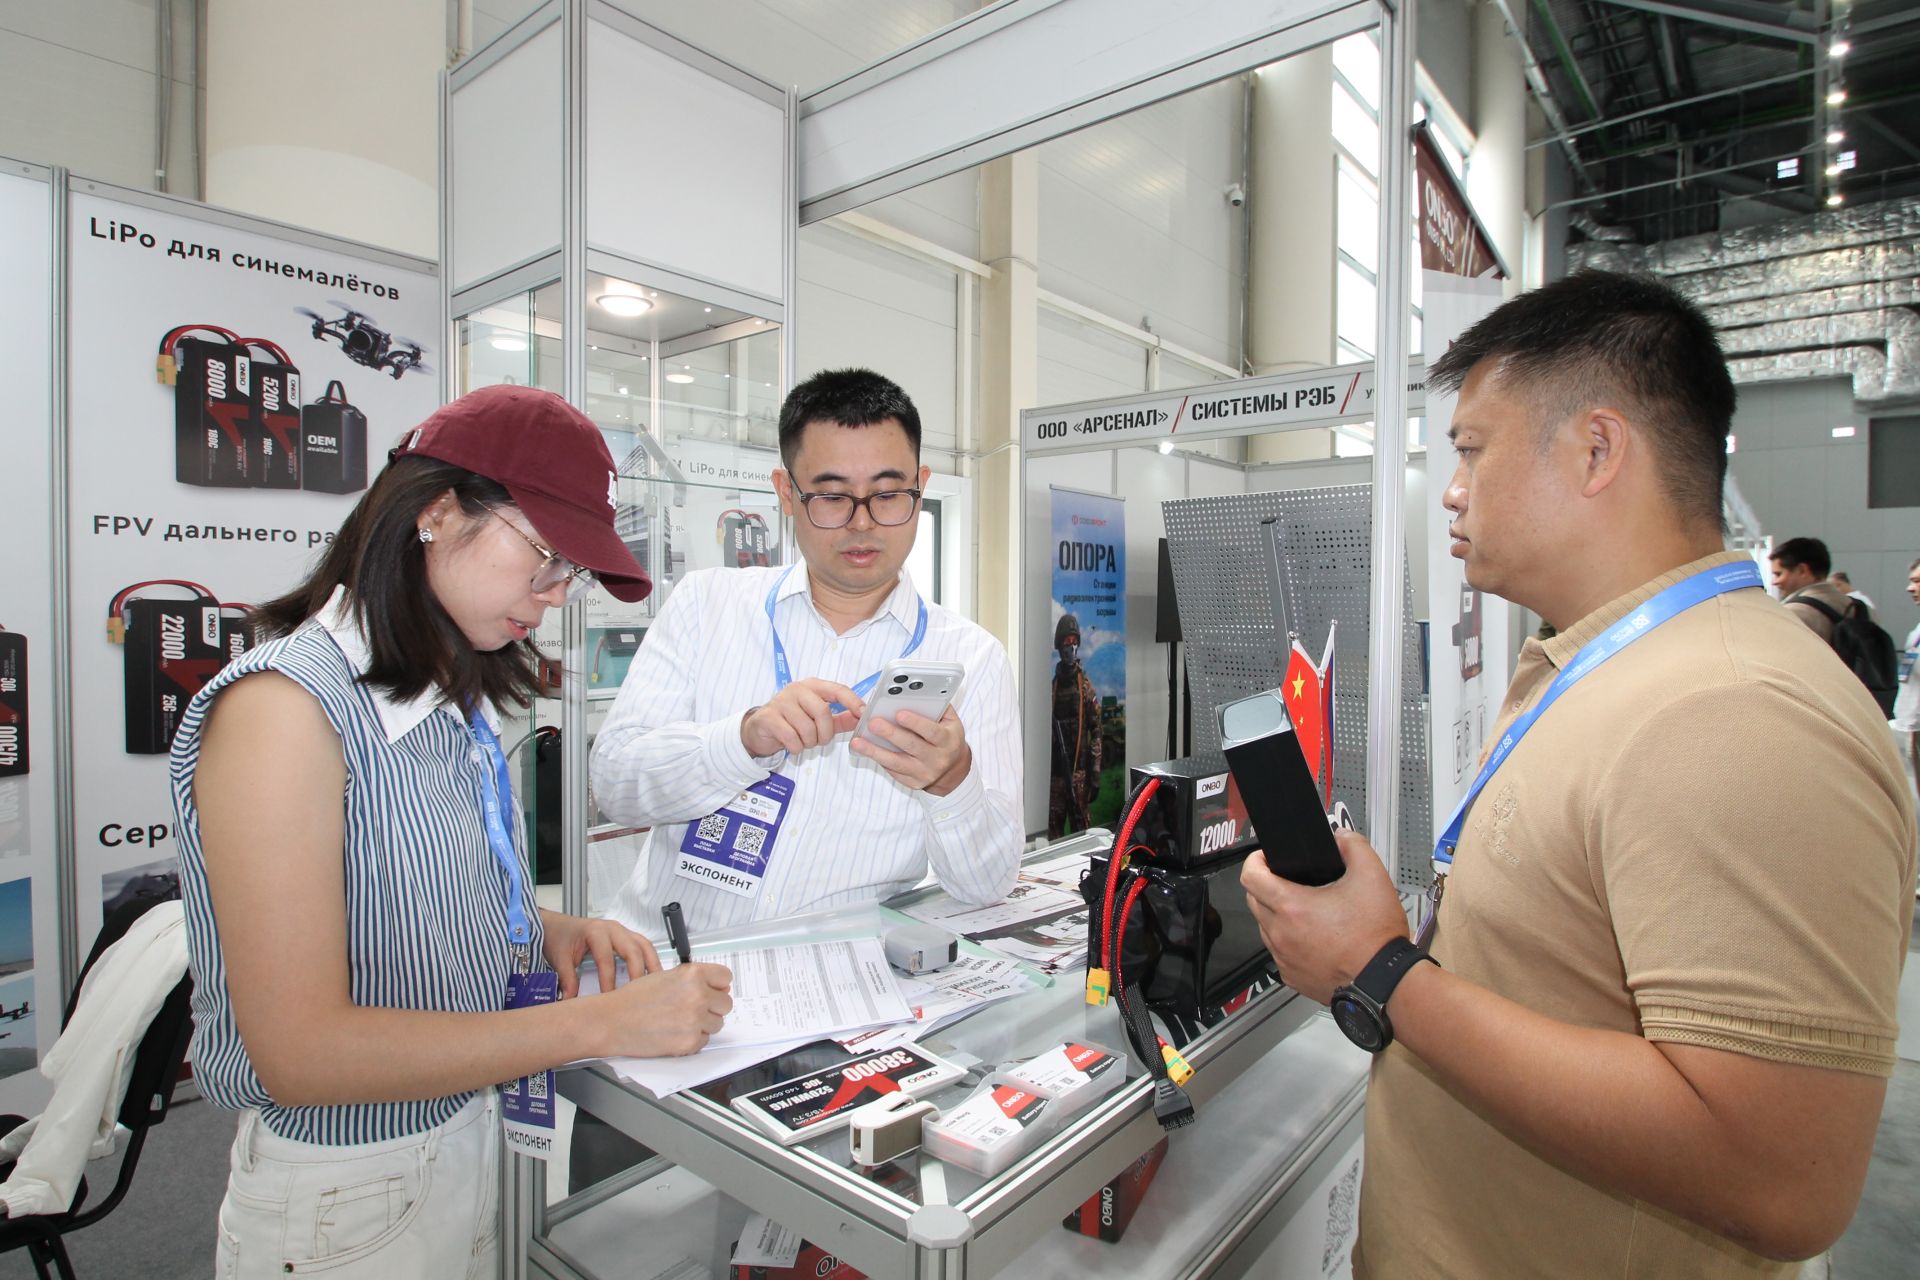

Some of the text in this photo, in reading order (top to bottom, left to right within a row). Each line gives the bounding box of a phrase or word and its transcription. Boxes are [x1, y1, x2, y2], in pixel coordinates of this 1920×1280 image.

[90, 217, 400, 301] LiPo для синемалётов
[207, 358, 226, 399] 8000
[262, 376, 280, 411] 5200
[1191, 385, 1336, 421] СИСТЕМЫ РЭБ
[1037, 409, 1169, 440] ООО «АРСЕНАЛ»
[307, 435, 337, 448] OEM
[689, 462, 715, 475] LiPo
[718, 468, 739, 478] для
[93, 515, 154, 537] FPV
[164, 523, 297, 544] дальнего
[1059, 540, 1117, 573] ОПОРА
[160, 613, 185, 661] 22000
[208, 613, 217, 638] ONBO
[229, 632, 244, 660] 1600
[0, 677, 17, 692] 10C
[162, 694, 177, 712] 25C
[1201, 780, 1221, 793] ONBO
[1199, 818, 1236, 855] 12000
[680, 859, 753, 891] ЭКСПОНЕНТ
[841, 1051, 914, 1082] 38000
[1072, 1049, 1095, 1064] ONBO
[802, 1078, 823, 1090] 10C
[907, 1070, 939, 1084] ONBO
[1001, 1091, 1026, 1109] ONBO
[506, 1128, 552, 1152] ЭКСПОНЕНТ
[1101, 1186, 1113, 1226] ONBO
